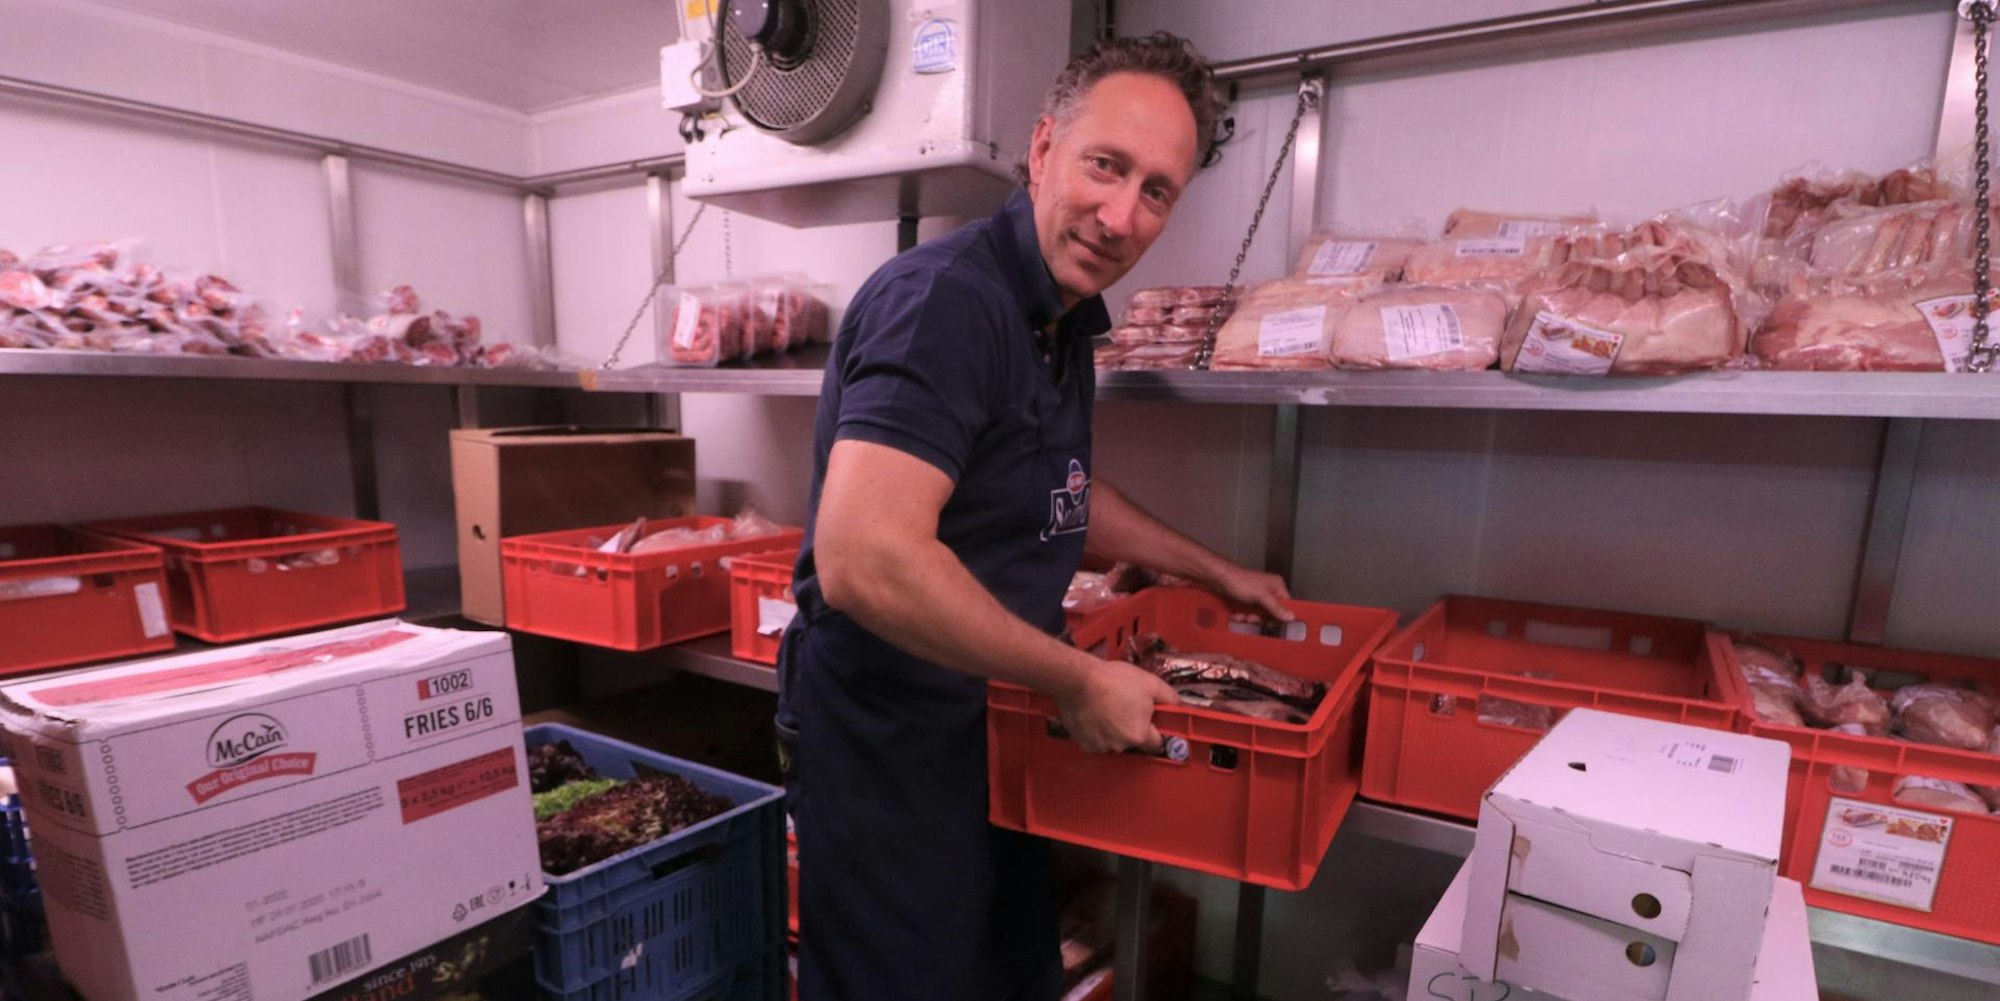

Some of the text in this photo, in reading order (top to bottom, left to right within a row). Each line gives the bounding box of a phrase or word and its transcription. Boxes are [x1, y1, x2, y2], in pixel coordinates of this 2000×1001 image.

[430, 672, 469, 693] 1002
[404, 697, 493, 739] FRIES 6/6
[214, 724, 285, 763] McCain
[195, 756, 310, 795] Our Original Choice
[363, 965, 406, 992] since
